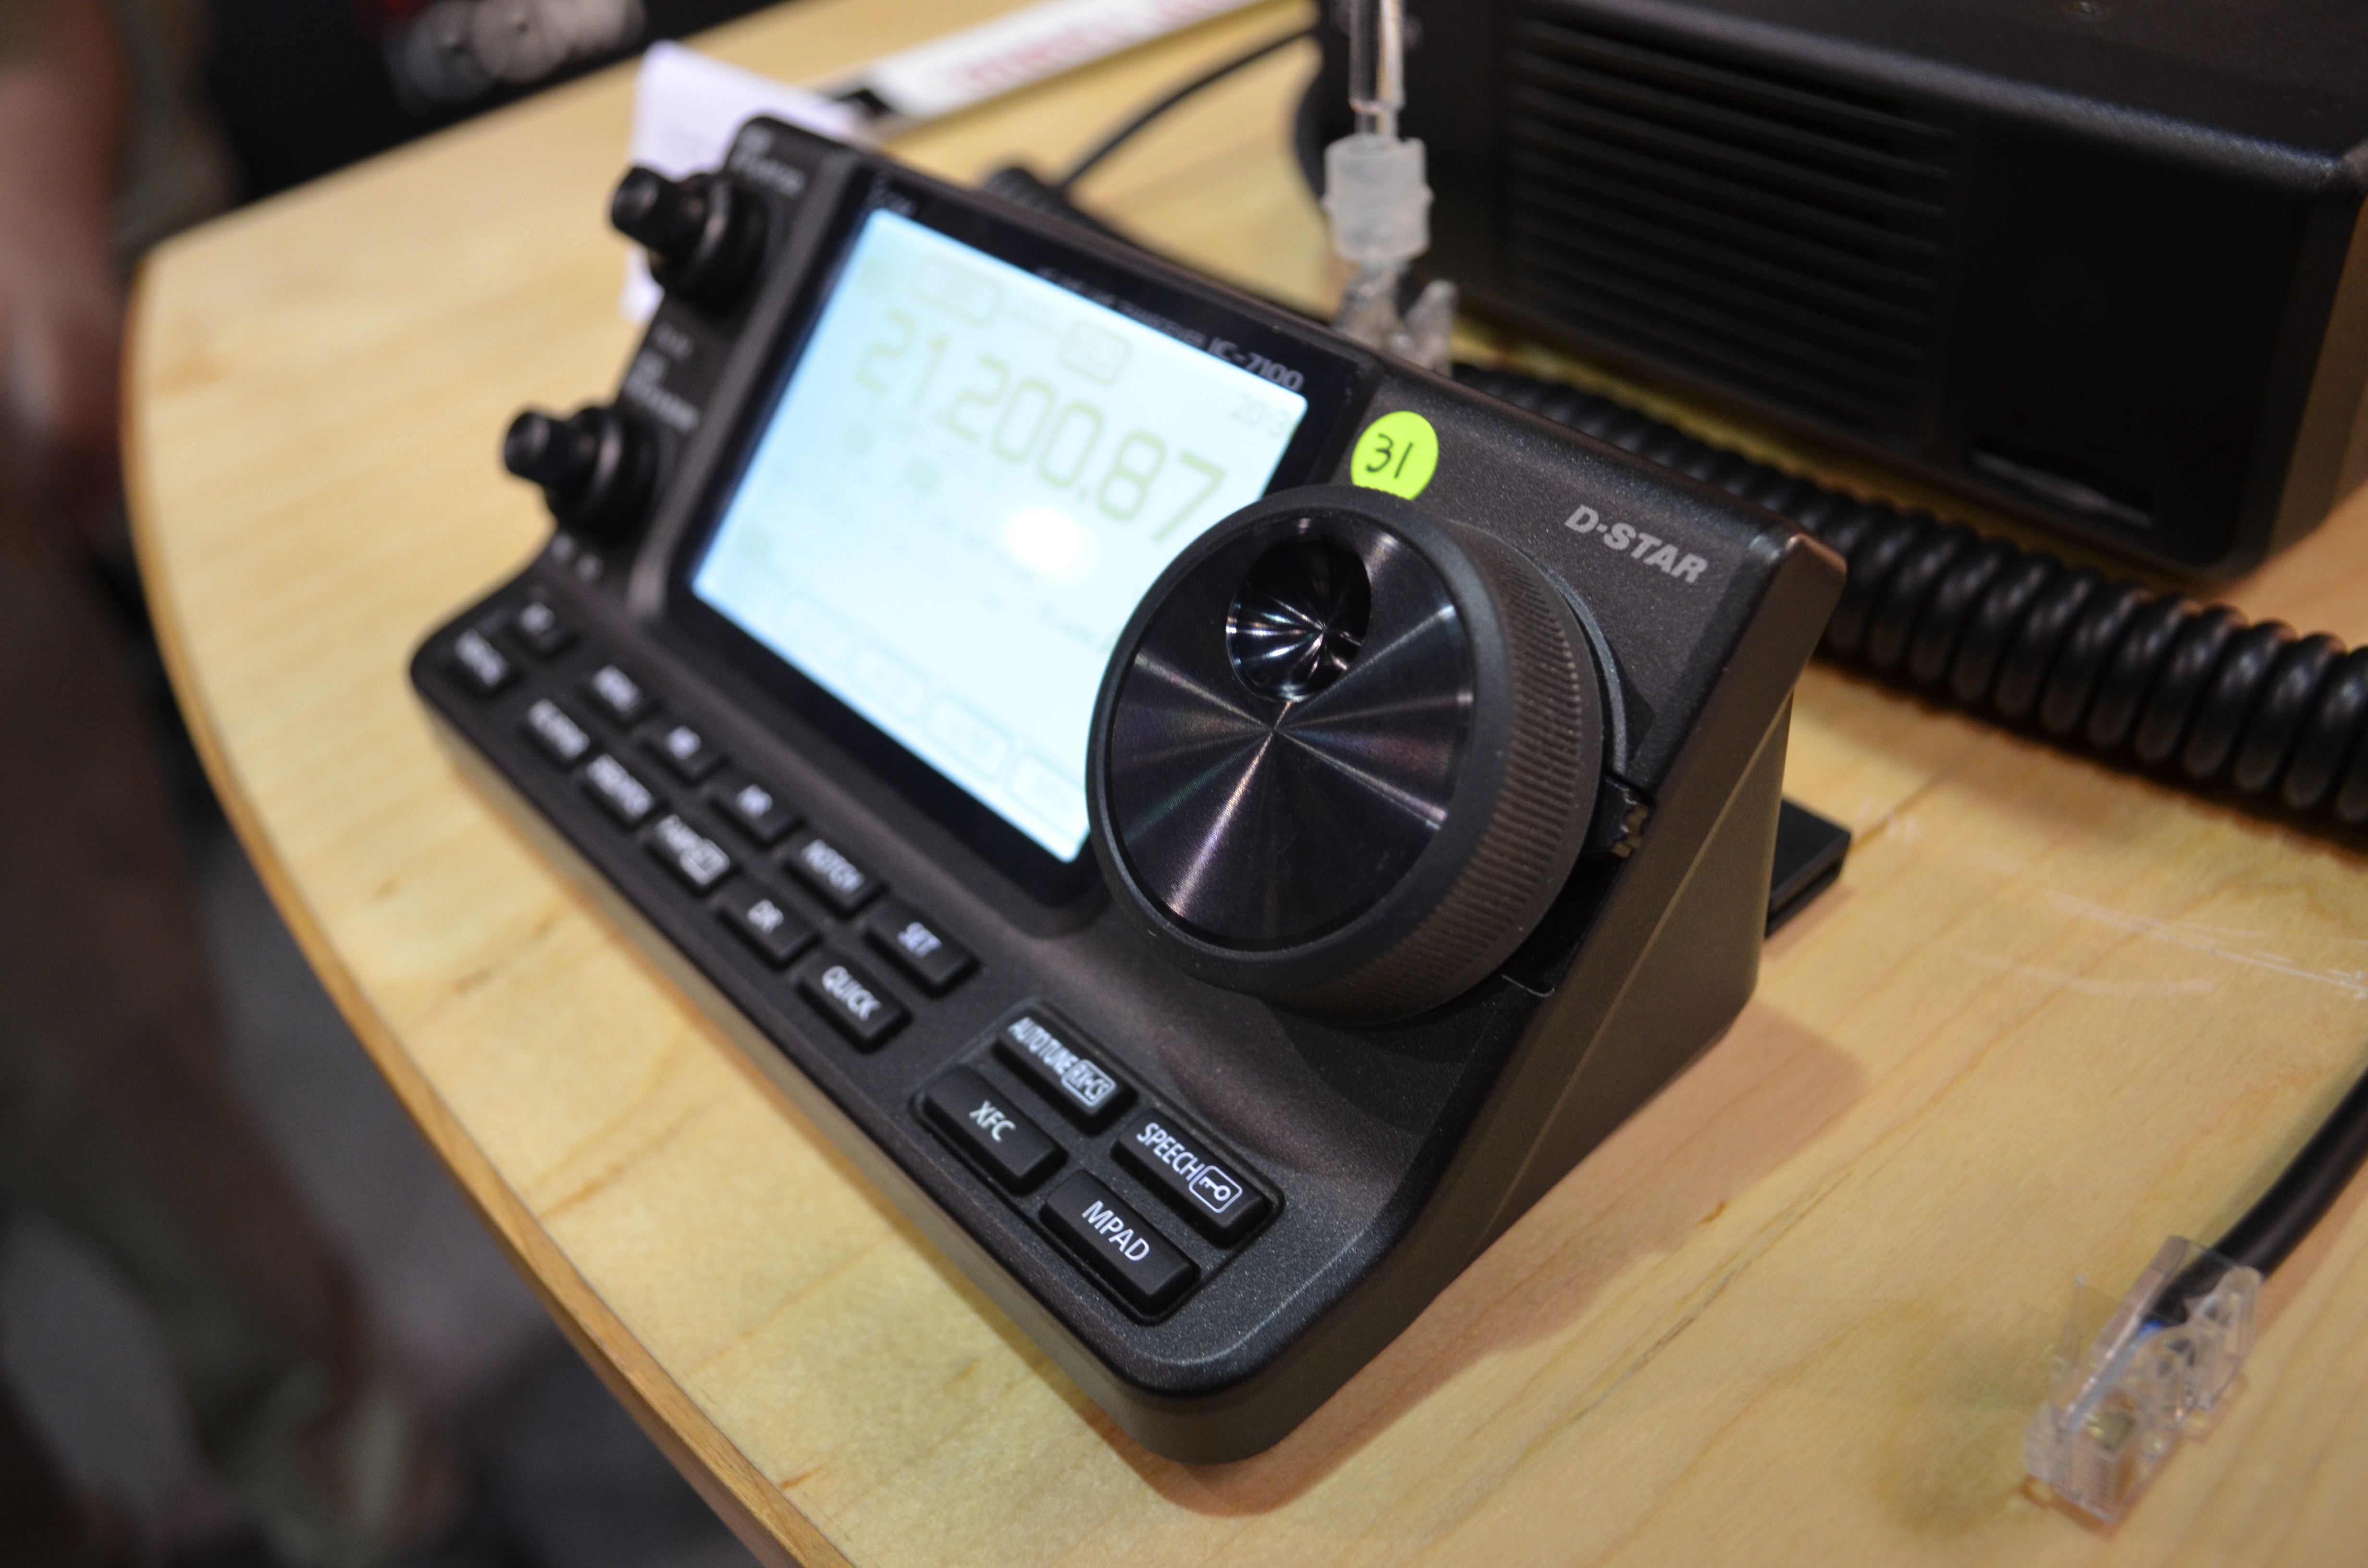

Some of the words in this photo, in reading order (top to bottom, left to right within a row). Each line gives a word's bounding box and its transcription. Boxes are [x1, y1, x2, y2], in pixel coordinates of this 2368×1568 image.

[1207, 337, 1305, 393] IC-7100
[854, 307, 1227, 544] 21.200.87
[1366, 433, 1413, 479] 31
[1565, 504, 1708, 584] D-STAR
[822, 965, 882, 1020] QUICK
[969, 1100, 1016, 1142] XFC
[1136, 1122, 1205, 1182] SPEECH
[1081, 1200, 1150, 1262] MPAD
